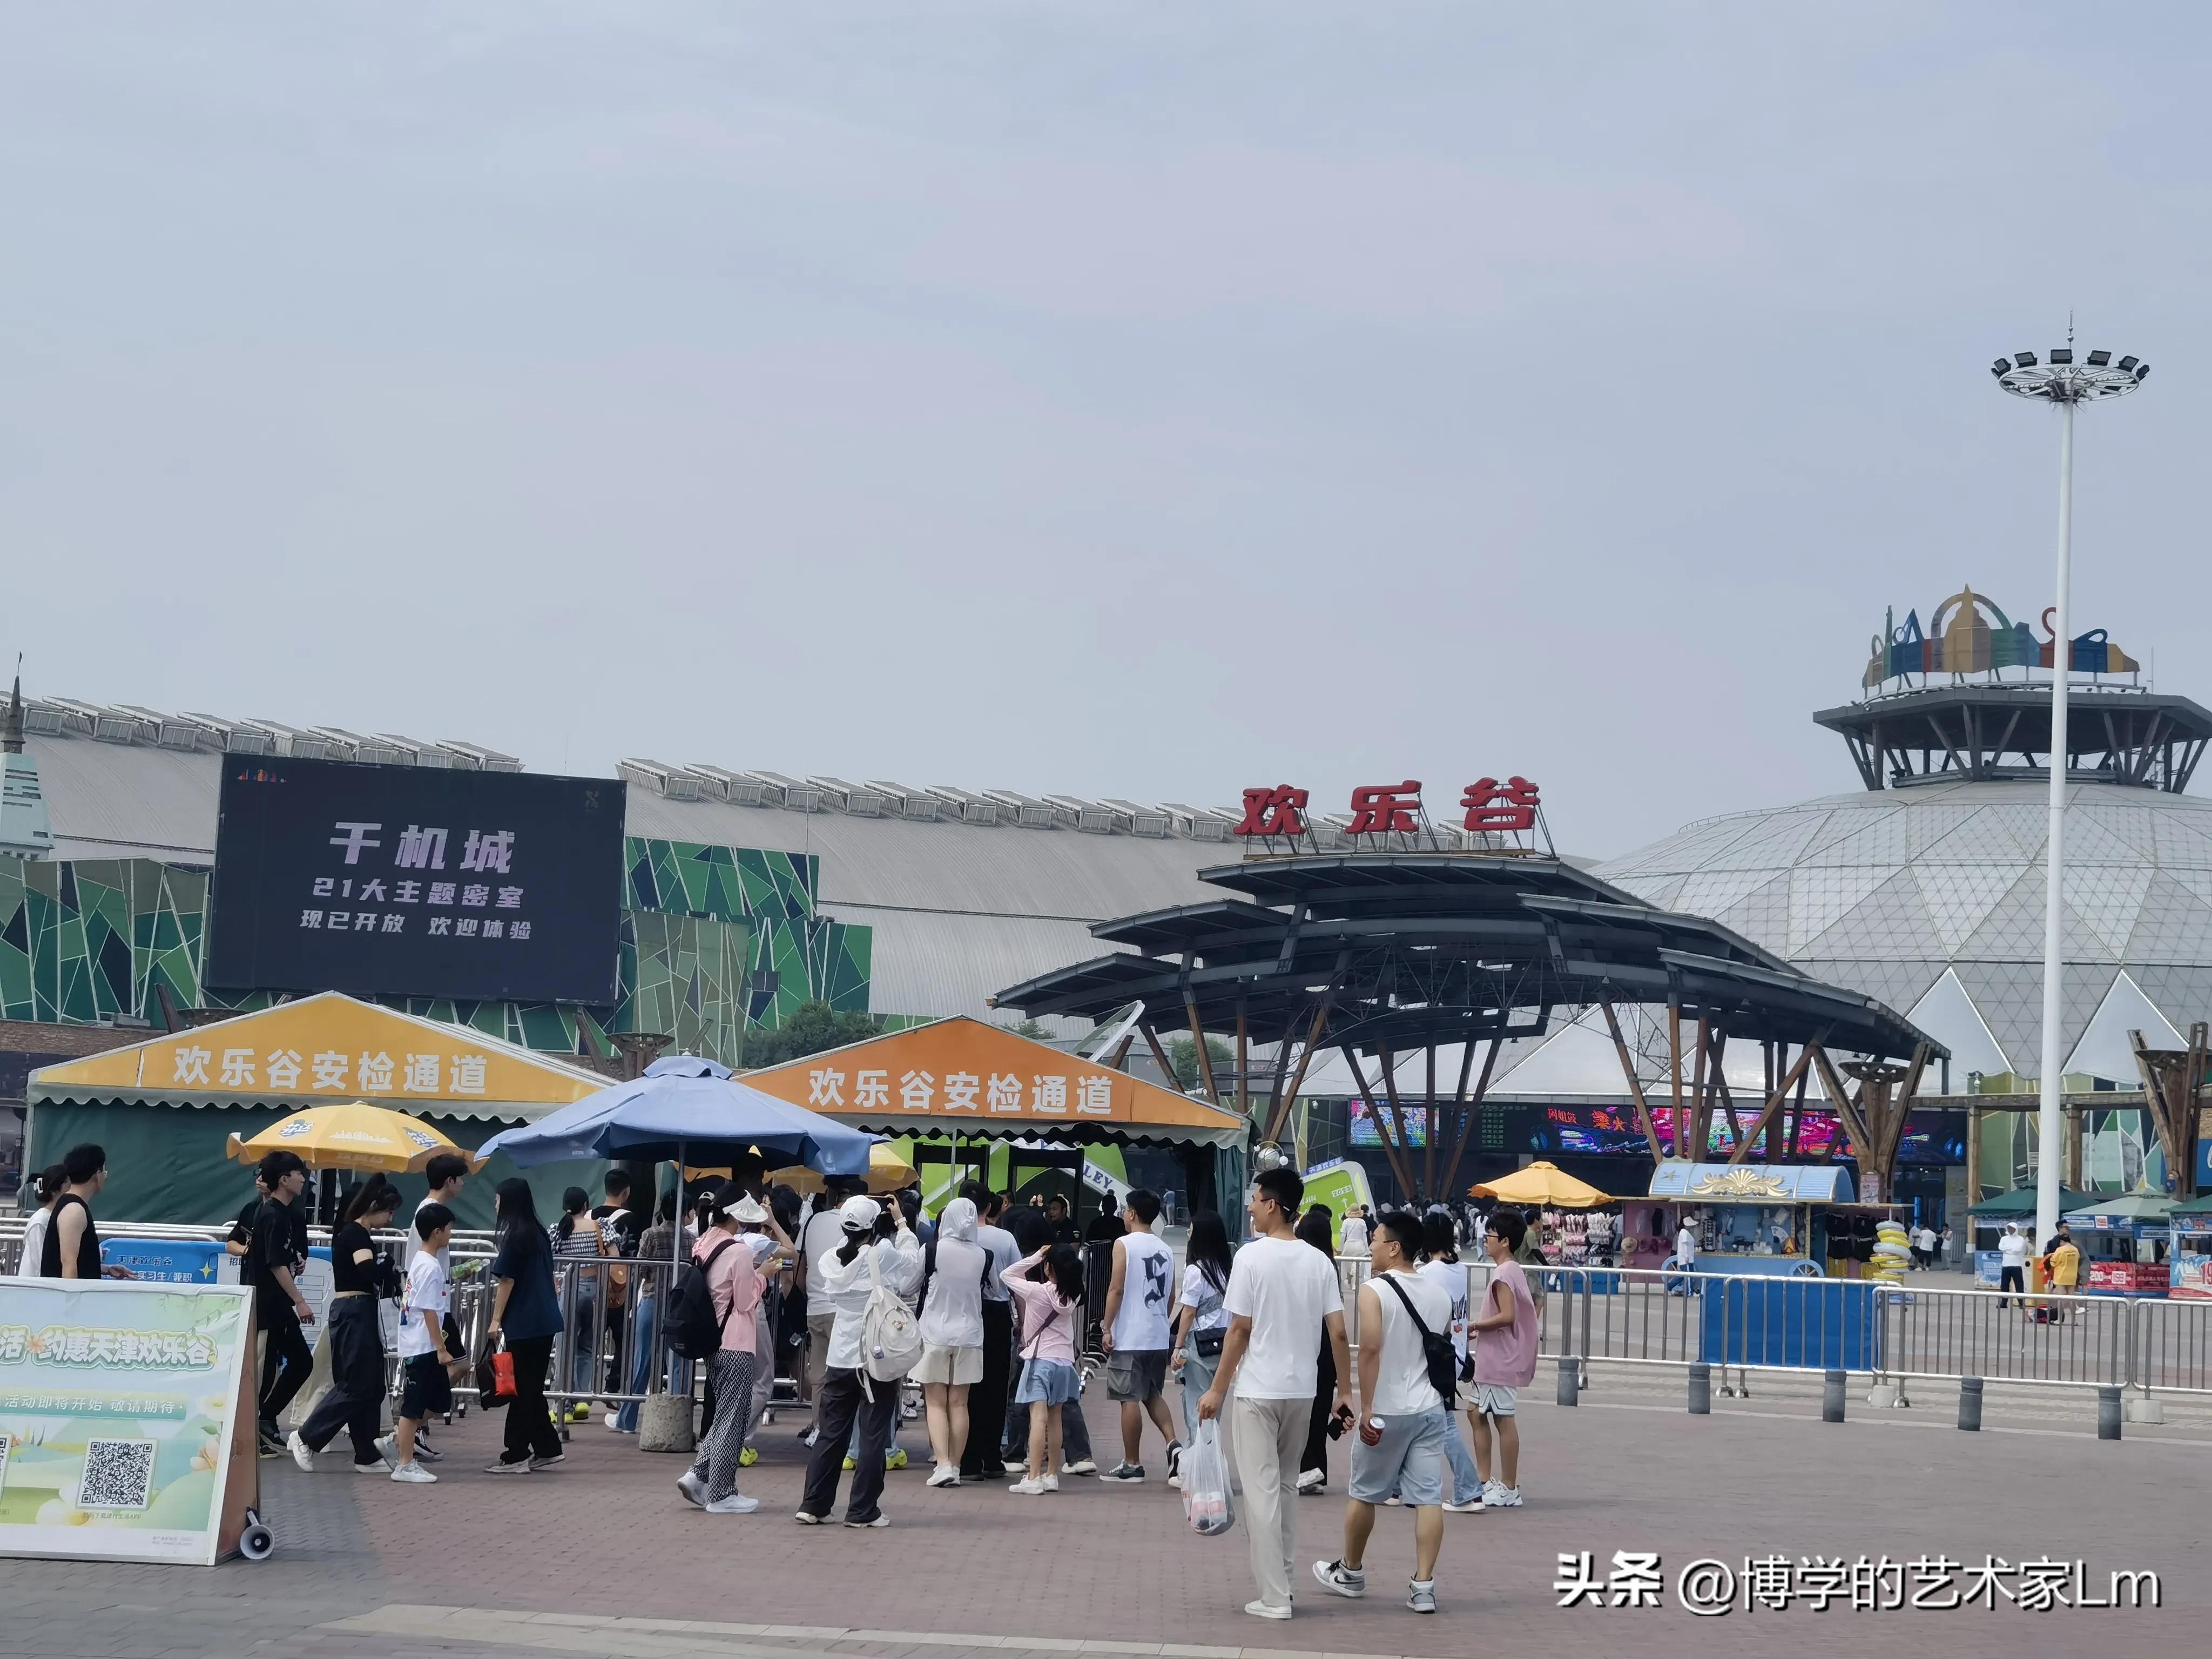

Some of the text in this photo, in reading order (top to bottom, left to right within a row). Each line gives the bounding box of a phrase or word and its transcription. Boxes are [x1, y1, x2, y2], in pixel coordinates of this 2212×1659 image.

[1233, 775, 1541, 835] 欢乐谷
[313, 878, 524, 908] 21大主题密室
[300, 909, 531, 939] 现已开放 欢迎体验
[173, 1044, 488, 1094] 欢乐谷安检通道
[808, 1067, 1112, 1115] 欢乐谷安检通道
[117, 1255, 173, 1266] 天津欢乐谷
[4, 1394, 174, 1414] 活动即将开始 敬请期待
